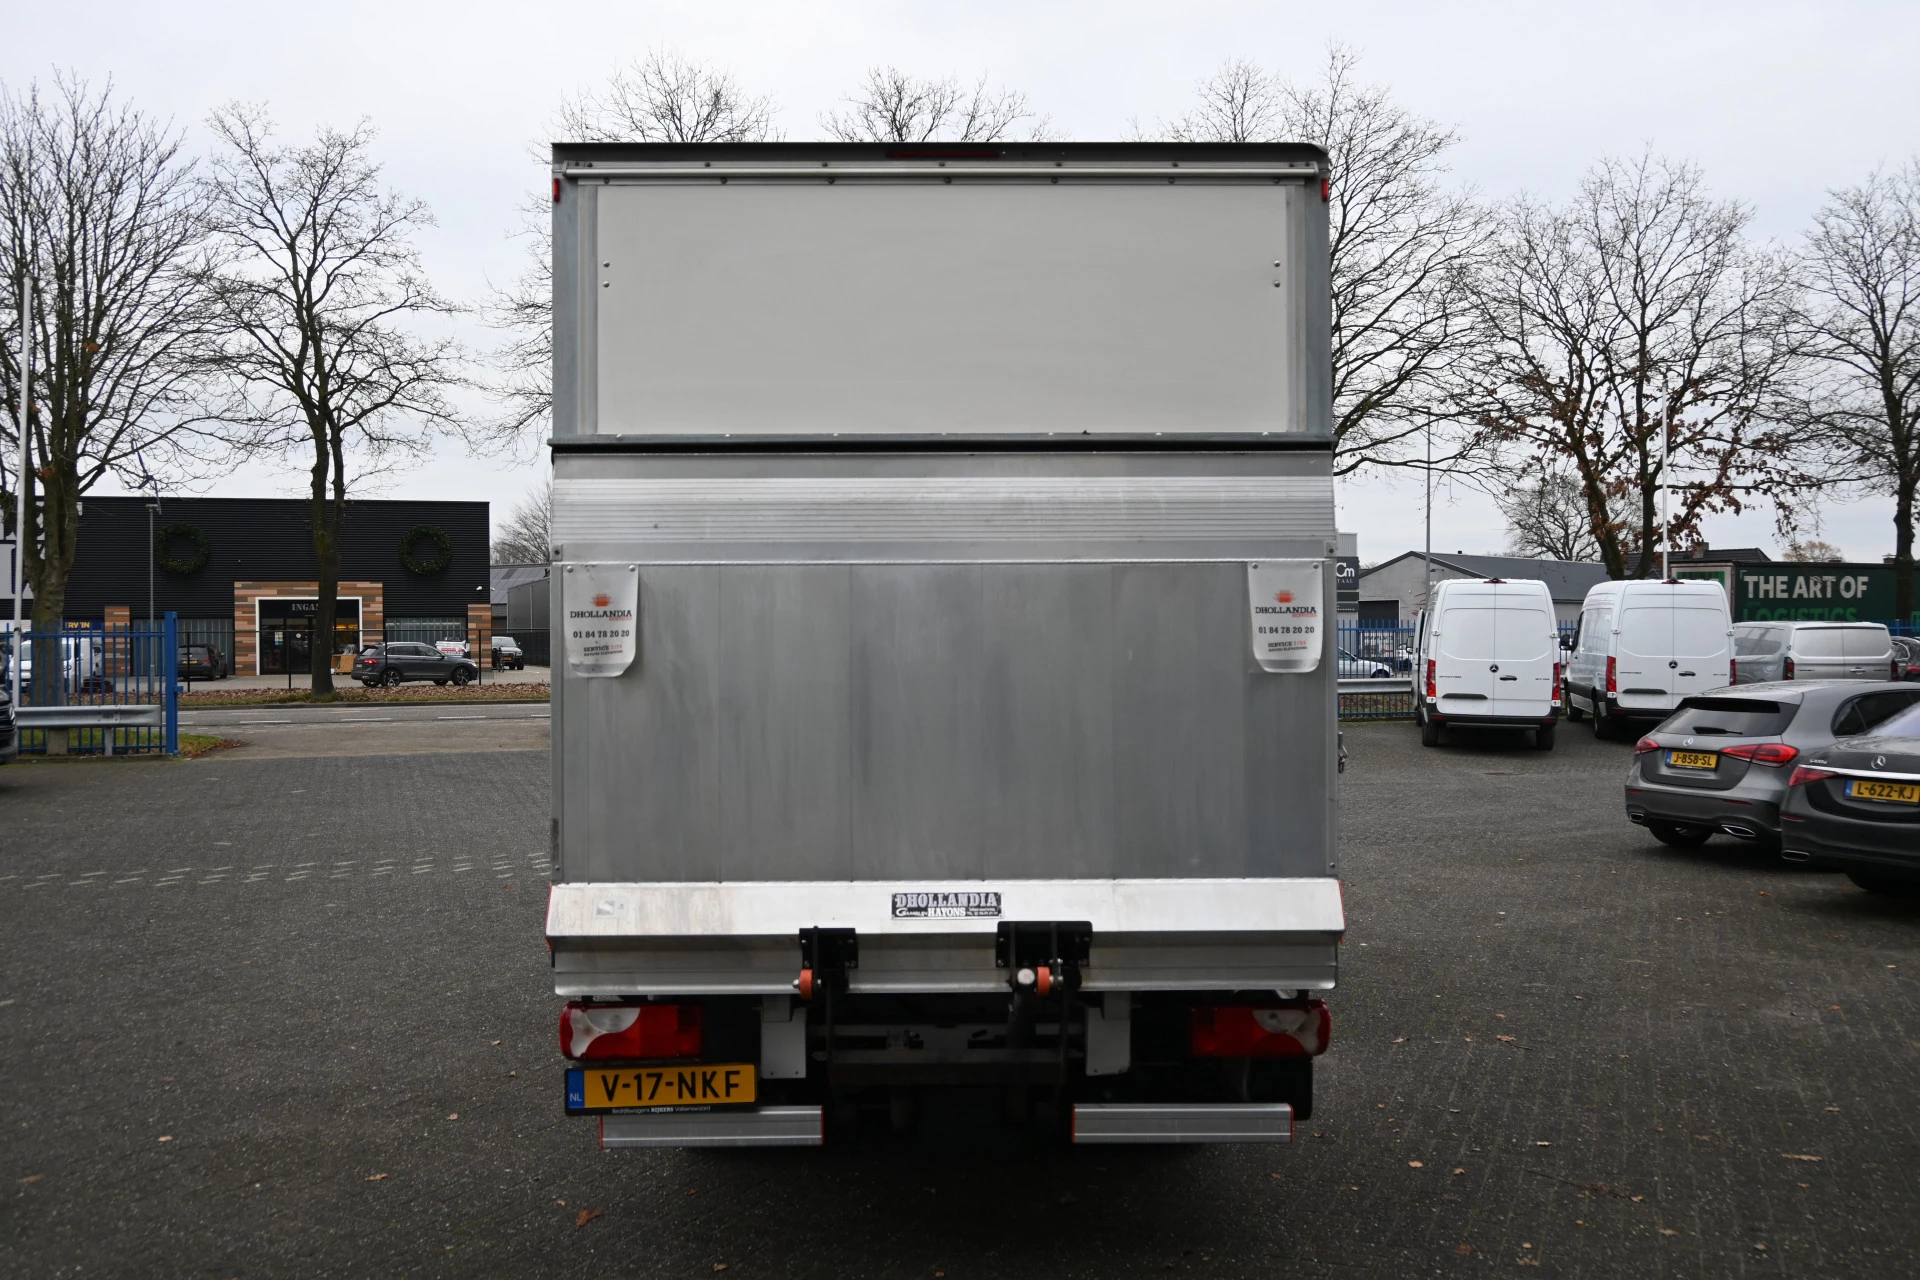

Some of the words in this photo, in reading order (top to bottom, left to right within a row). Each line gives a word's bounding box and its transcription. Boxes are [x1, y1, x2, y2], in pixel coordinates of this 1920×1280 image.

[1744, 575, 1790, 598] THE
[1792, 575, 1836, 598] ART
[1839, 575, 1868, 598] OF
[570, 610, 632, 618] DHOLLANDIA
[1256, 606, 1316, 614] DHOLLANDIA
[573, 630, 582, 638] 01
[585, 630, 595, 638] 84
[598, 630, 607, 638] 78
[609, 630, 619, 638] 20
[1258, 626, 1267, 634] 01
[1269, 626, 1279, 634] 84
[1281, 626, 1290, 634] 78
[1292, 626, 1302, 634] 20
[1304, 626, 1314, 634] 20
[1673, 753, 1712, 766] J-858-SL
[1857, 782, 1915, 800] L-622-KJ
[894, 892, 997, 908] DHOLLANDIA
[928, 908, 966, 917] HAYONS
[600, 1070, 741, 1102] V-17-NKF
[569, 1093, 583, 1102] NL
